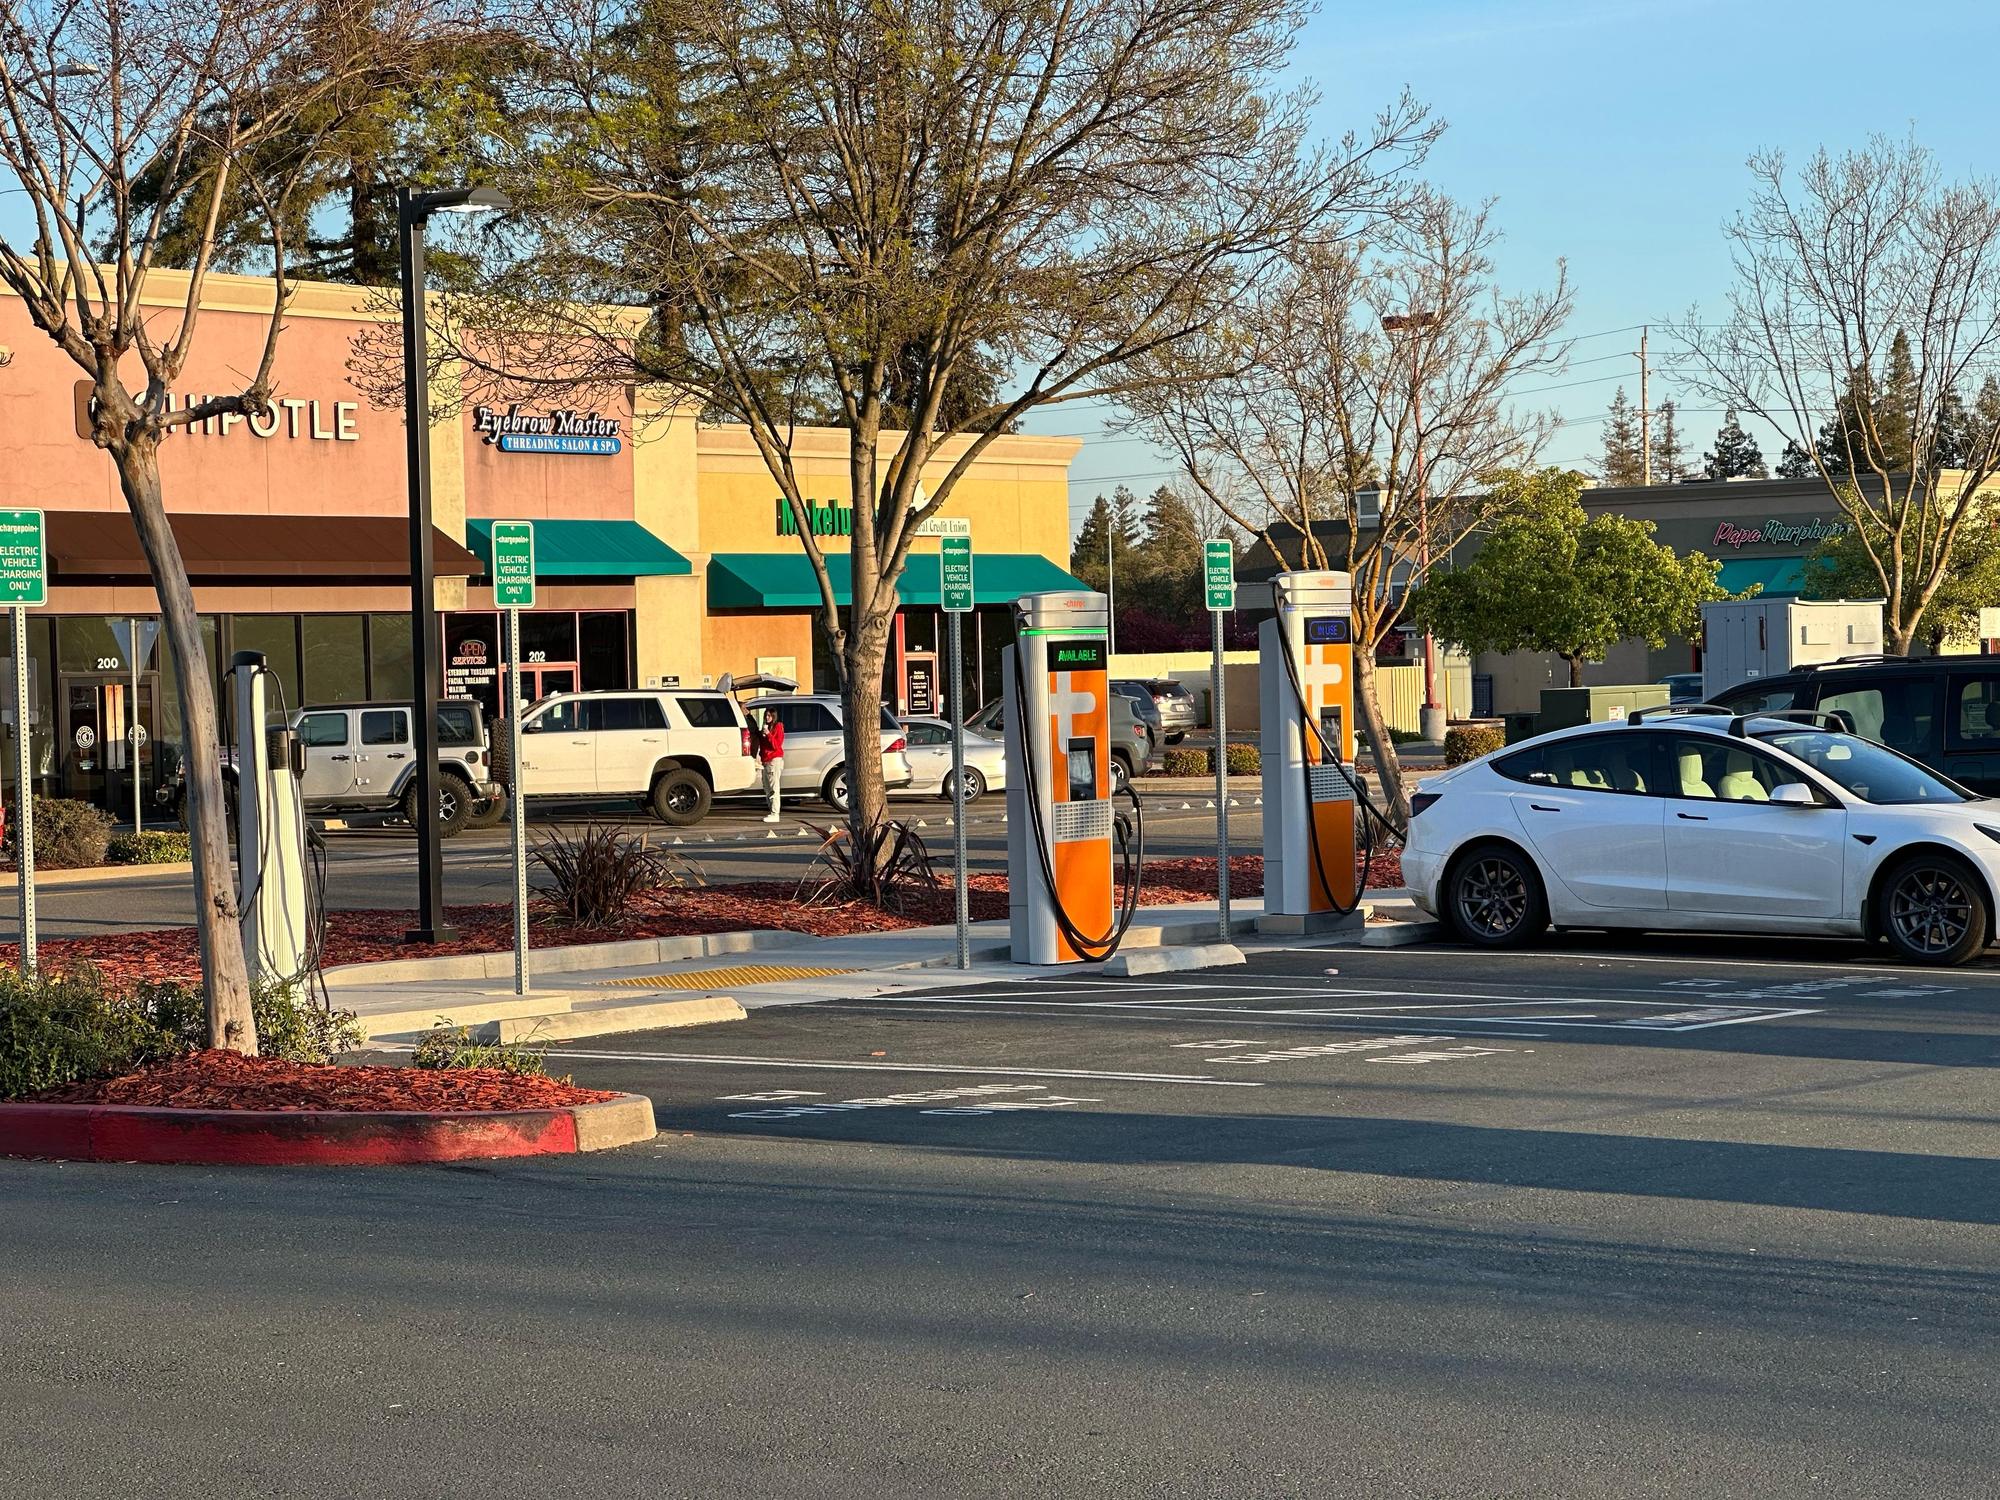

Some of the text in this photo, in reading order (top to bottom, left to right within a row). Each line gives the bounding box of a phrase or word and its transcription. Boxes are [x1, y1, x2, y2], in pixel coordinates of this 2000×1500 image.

[478, 404, 620, 443] Eyebrow Masters
[506, 437, 616, 451] THREADING SALON & SPA
[1713, 521, 1761, 548] Papa
[0, 546, 39, 556] ELECTRIC
[1, 558, 37, 567] VEHICLE
[498, 555, 529, 564] ELECTRIC
[500, 565, 528, 574] VEHICLE
[945, 564, 969, 573] ELECTRIC
[1208, 567, 1230, 575] ELECTRIC
[497, 576, 531, 585] CHARGING
[946, 574, 968, 582] VEHICLE
[1209, 575, 1229, 583] VEHICLE
[9, 581, 31, 591] ONLY
[506, 586, 523, 595] ONLY
[944, 583, 971, 591] CHARGING
[950, 592, 965, 600] ONLY
[1213, 592, 1226, 600] ONLY
[460, 641, 486, 656] OPEN
[452, 656, 487, 665] SERVICES
[529, 651, 546, 662] 202
[1058, 649, 1097, 662] AVAILABLE
[97, 658, 118, 669] 200
[1170, 1039, 1267, 1049] EV
[1204, 1035, 1456, 1064] CHARGING
[1365, 1045, 1516, 1064] ONLY
[714, 1089, 827, 1101] EV
[727, 1083, 1048, 1119] CHARGING
[919, 1095, 1104, 1116] ONLY
